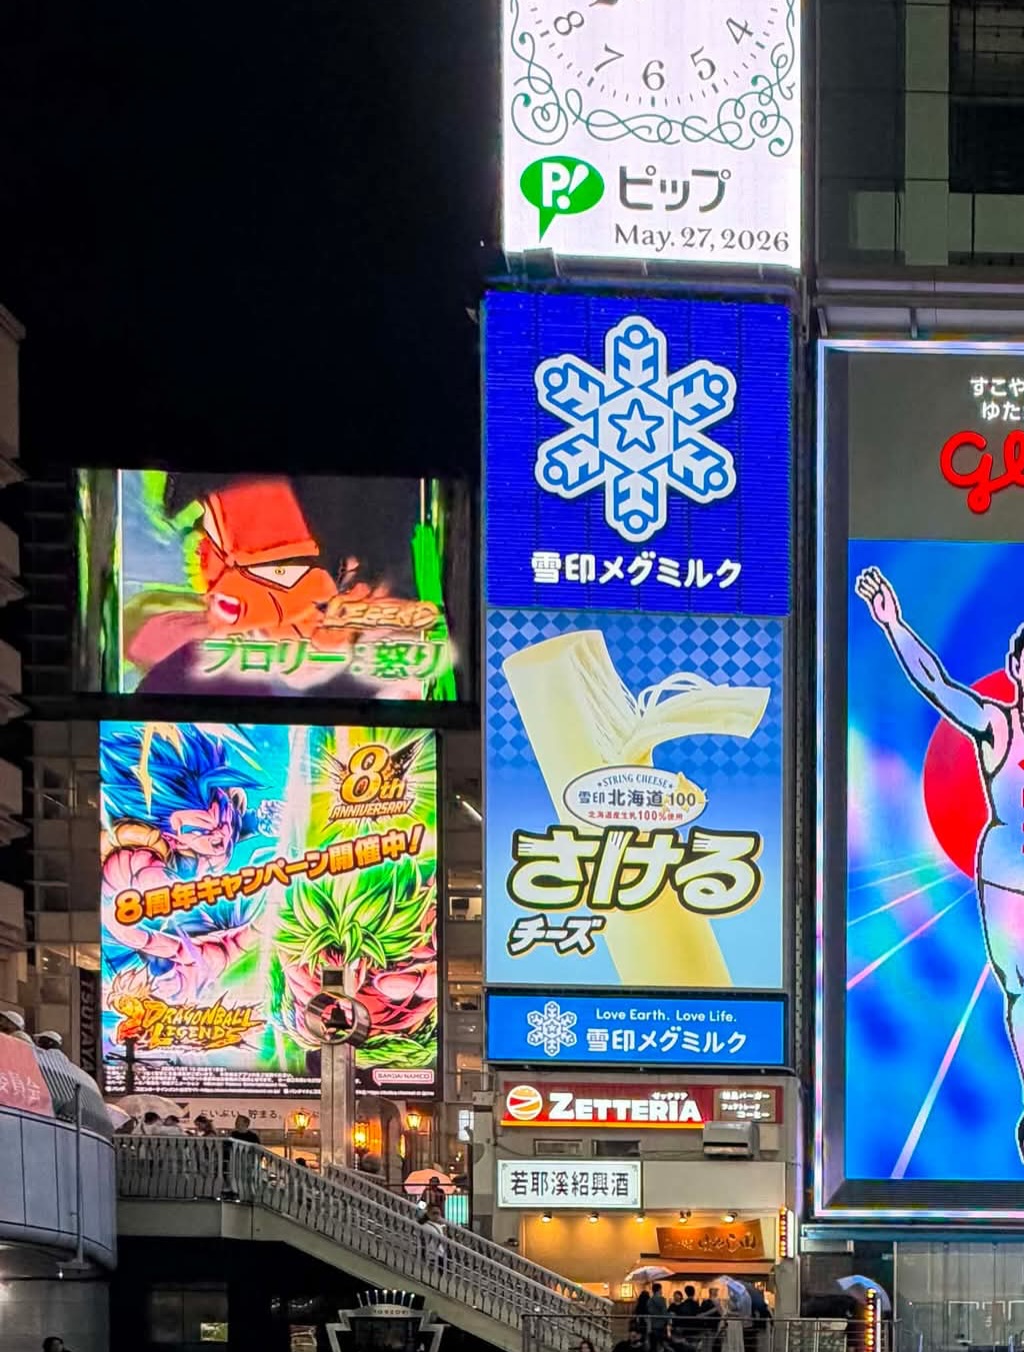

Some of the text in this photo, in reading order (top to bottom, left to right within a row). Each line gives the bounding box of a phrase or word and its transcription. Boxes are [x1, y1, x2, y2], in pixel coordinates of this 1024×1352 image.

[554, 11, 585, 36] 8
[726, 17, 754, 45] 4
[594, 44, 625, 73] 7
[690, 46, 716, 81] 5
[642, 60, 665, 91] 6
[618, 165, 732, 213] ピップ
[721, 229, 790, 252] 2026
[530, 550, 742, 589] 雪印メグミルク
[604, 774, 667, 788] STRING CHEESE
[331, 801, 410, 819] ANNIVERSARY
[508, 826, 760, 914] さける
[507, 915, 606, 955] チーズ
[596, 1008, 737, 1023] Love Earth. Love Life.
[150, 1023, 246, 1050] LEGENDS
[586, 1026, 747, 1054] 雪印メグミルク
[549, 1092, 703, 1122] ZETTERIA
